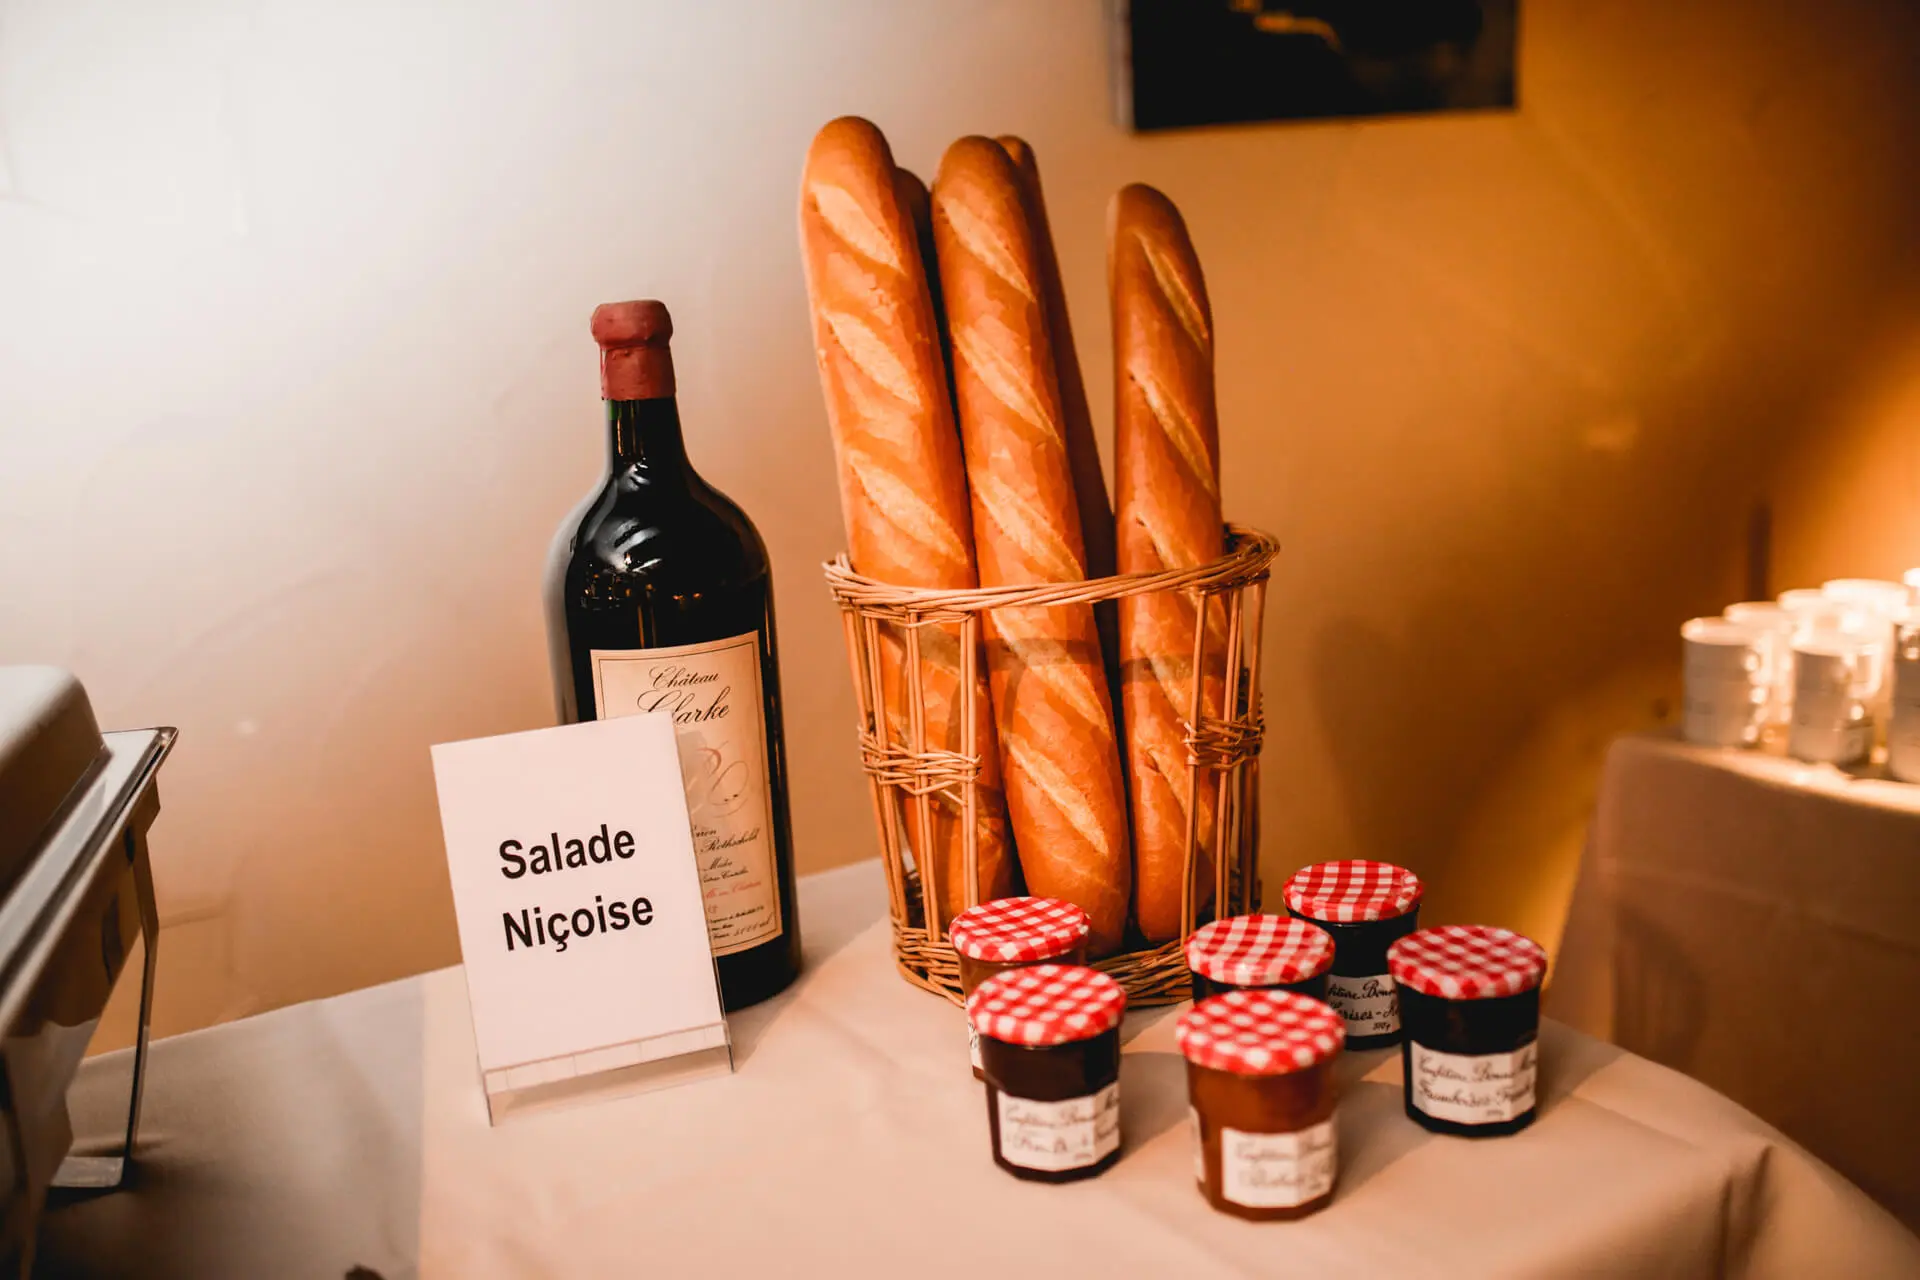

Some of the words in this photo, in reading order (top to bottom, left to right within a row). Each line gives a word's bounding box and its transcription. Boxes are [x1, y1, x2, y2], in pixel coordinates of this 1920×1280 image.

[648, 665, 719, 690] Château
[637, 686, 731, 725] Clarke
[499, 823, 636, 880] Salade
[502, 895, 654, 953] Niçoise
